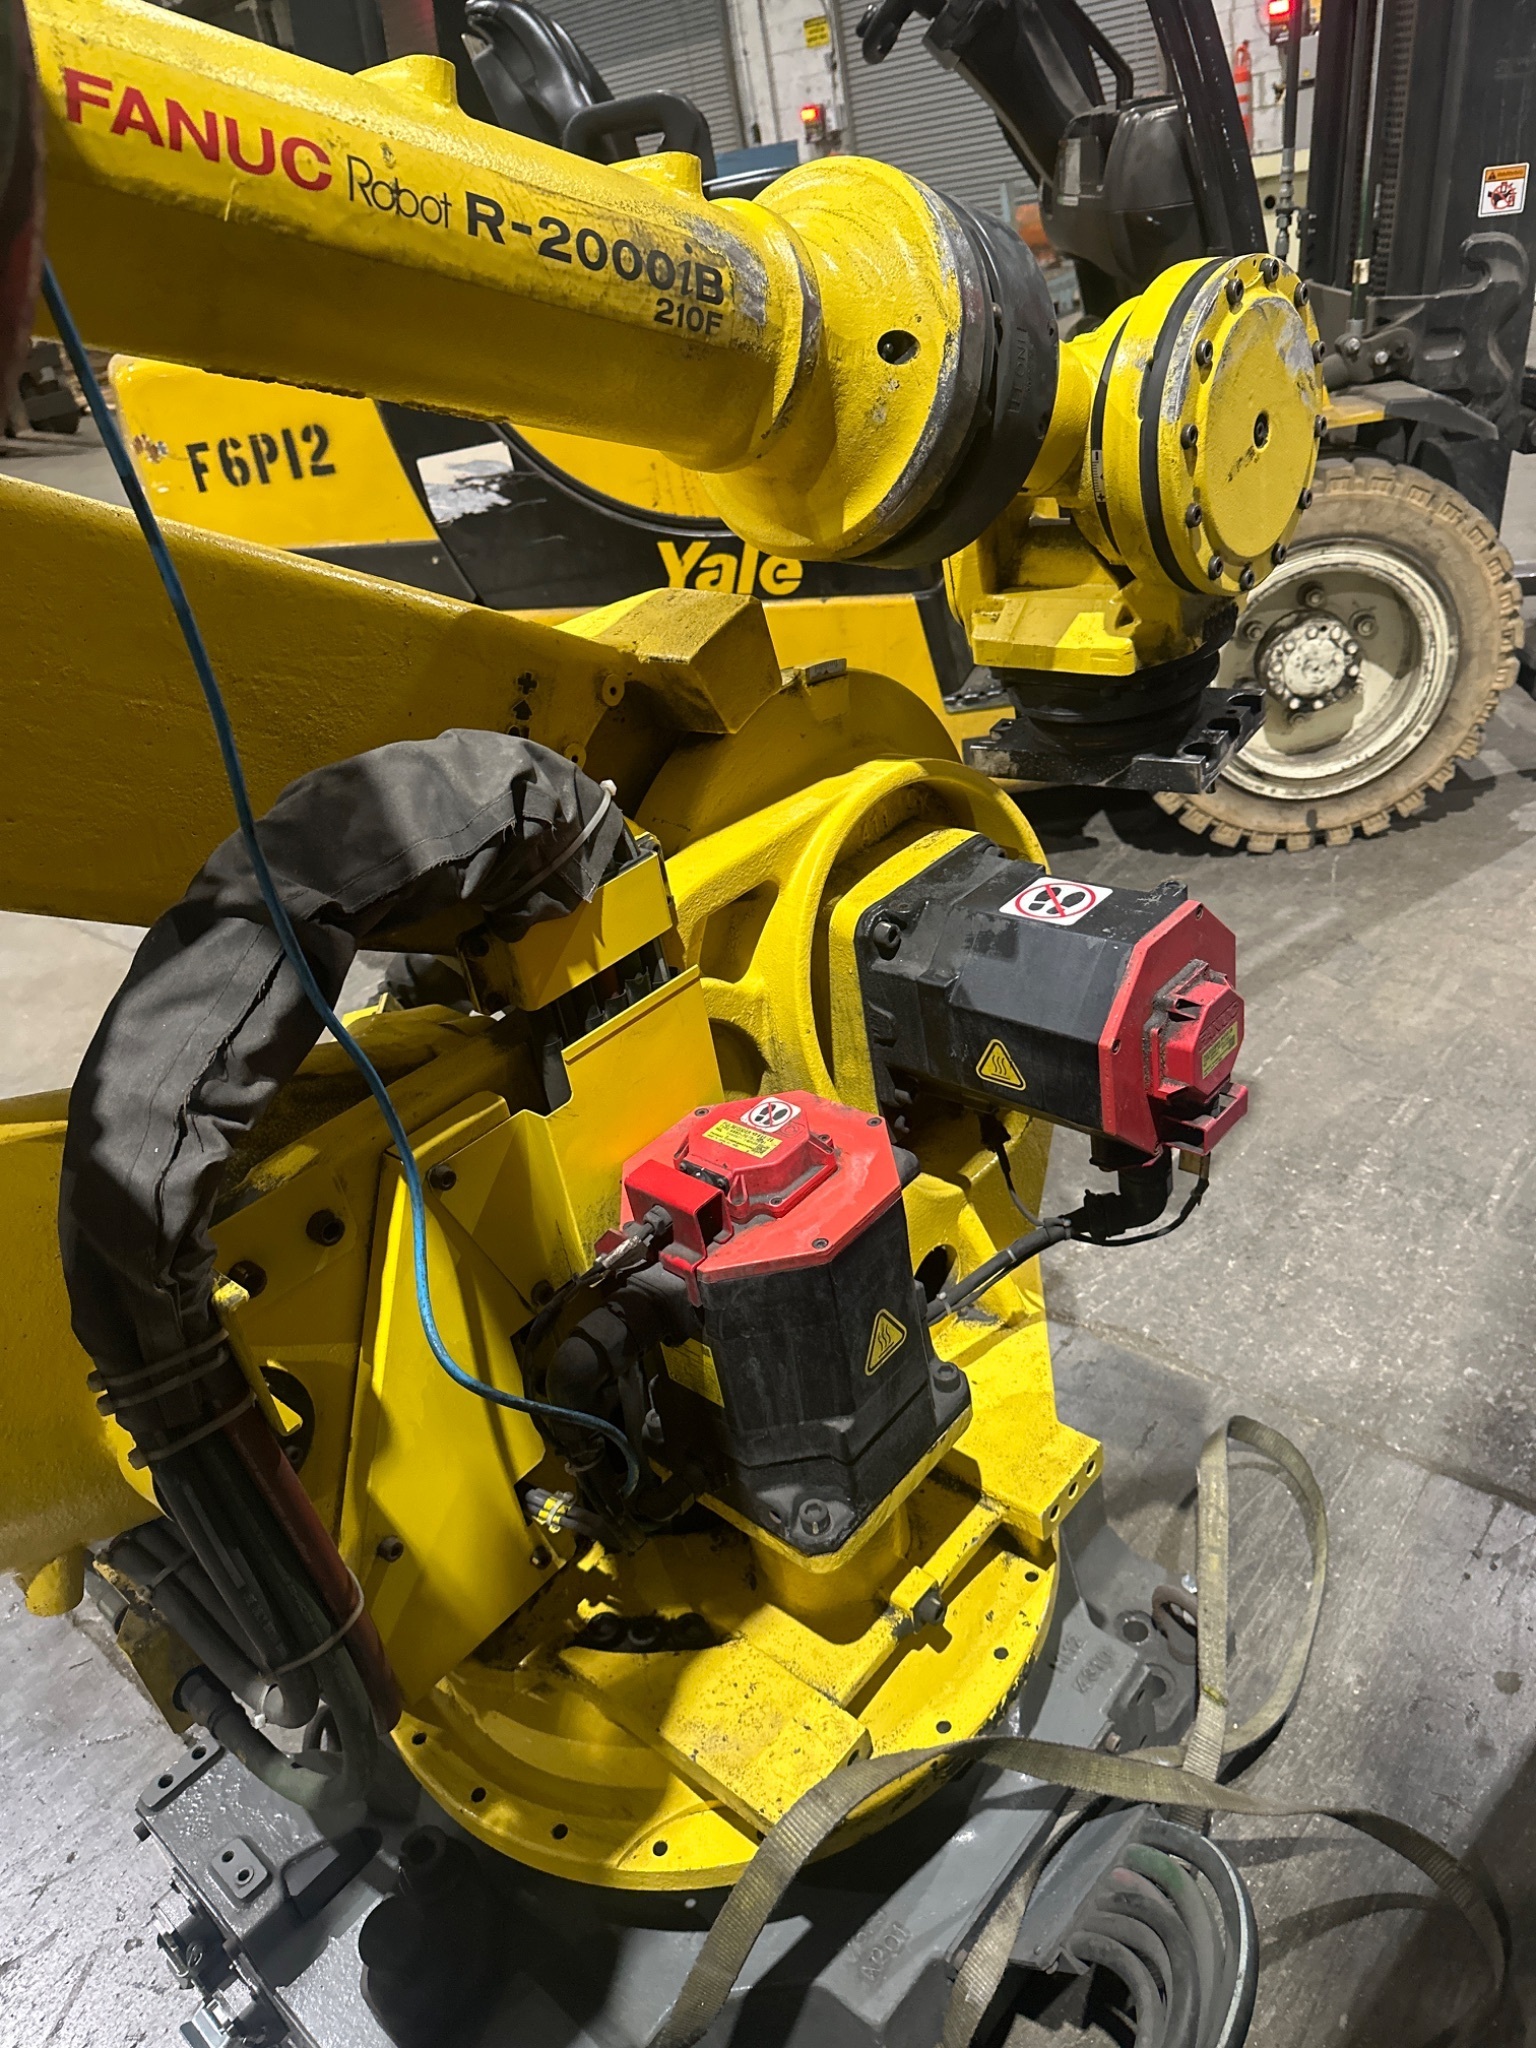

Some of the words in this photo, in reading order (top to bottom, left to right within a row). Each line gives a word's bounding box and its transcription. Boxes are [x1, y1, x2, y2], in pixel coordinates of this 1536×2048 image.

[63, 67, 333, 192] FANUC
[346, 154, 453, 229] Robot
[465, 190, 725, 306] R-2000iB
[653, 298, 724, 336] 210F
[657, 541, 804, 596] Yale
